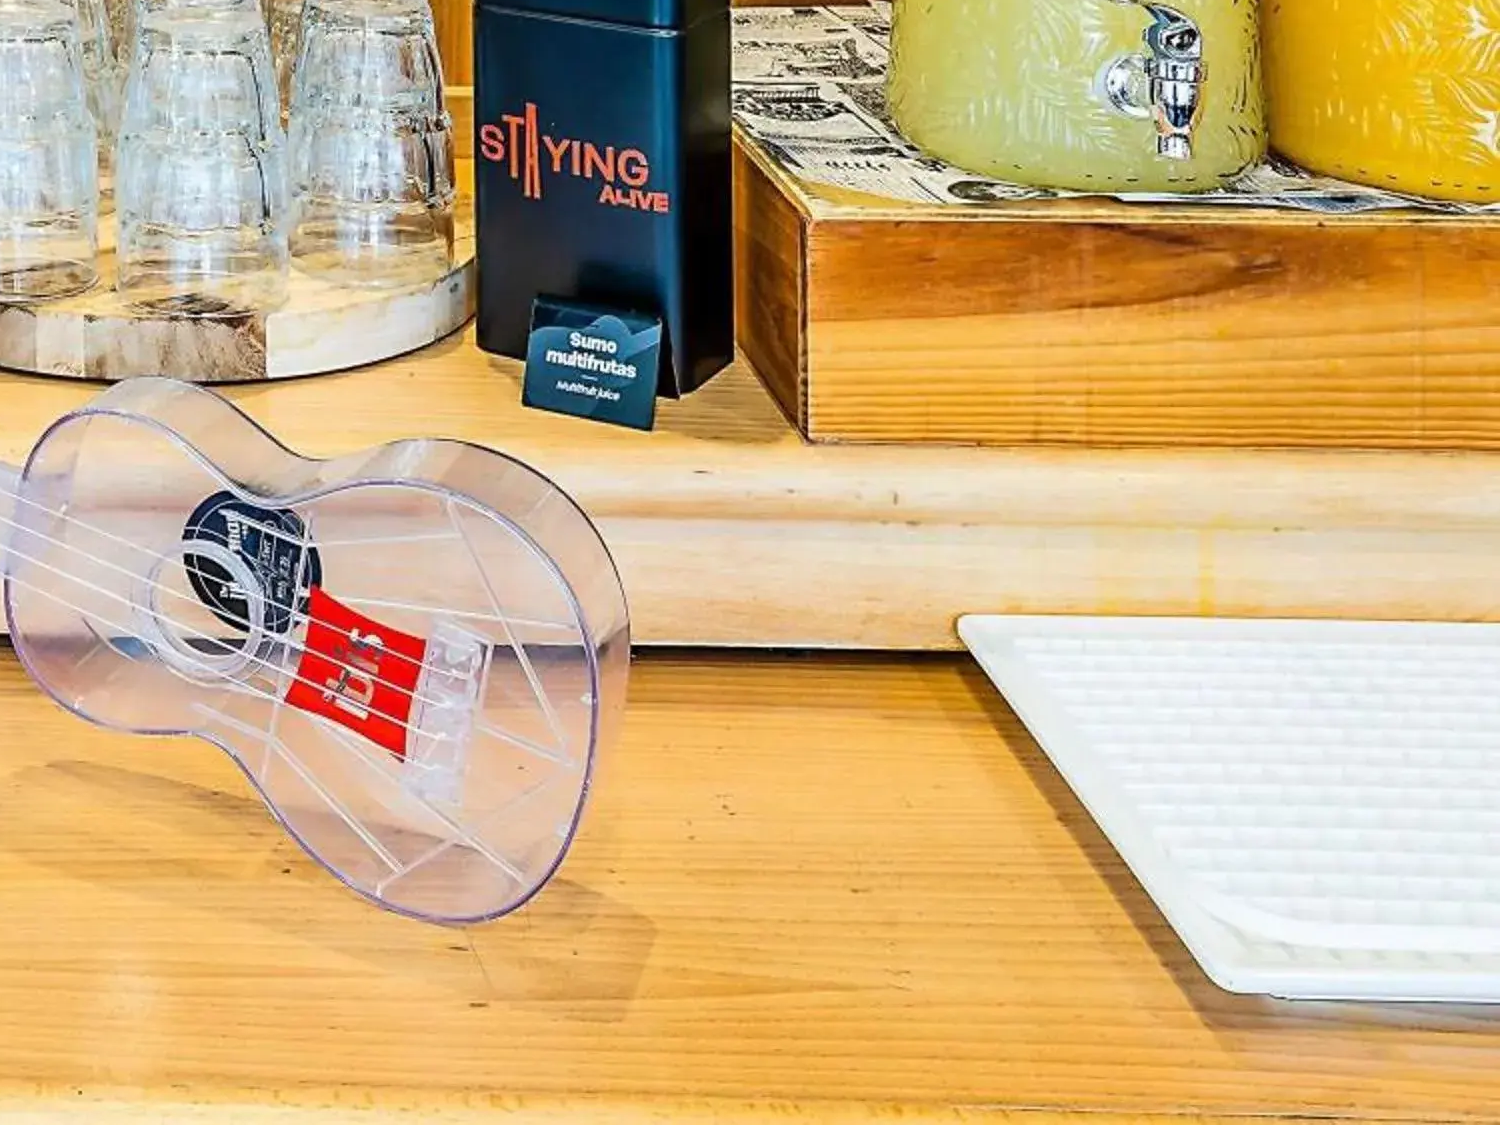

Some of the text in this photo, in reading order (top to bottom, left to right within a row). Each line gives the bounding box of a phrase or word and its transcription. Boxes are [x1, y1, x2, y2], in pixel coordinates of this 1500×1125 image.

[479, 101, 650, 200] STAYING
[569, 332, 617, 354] Sumo
[545, 349, 637, 378] multifrutas
